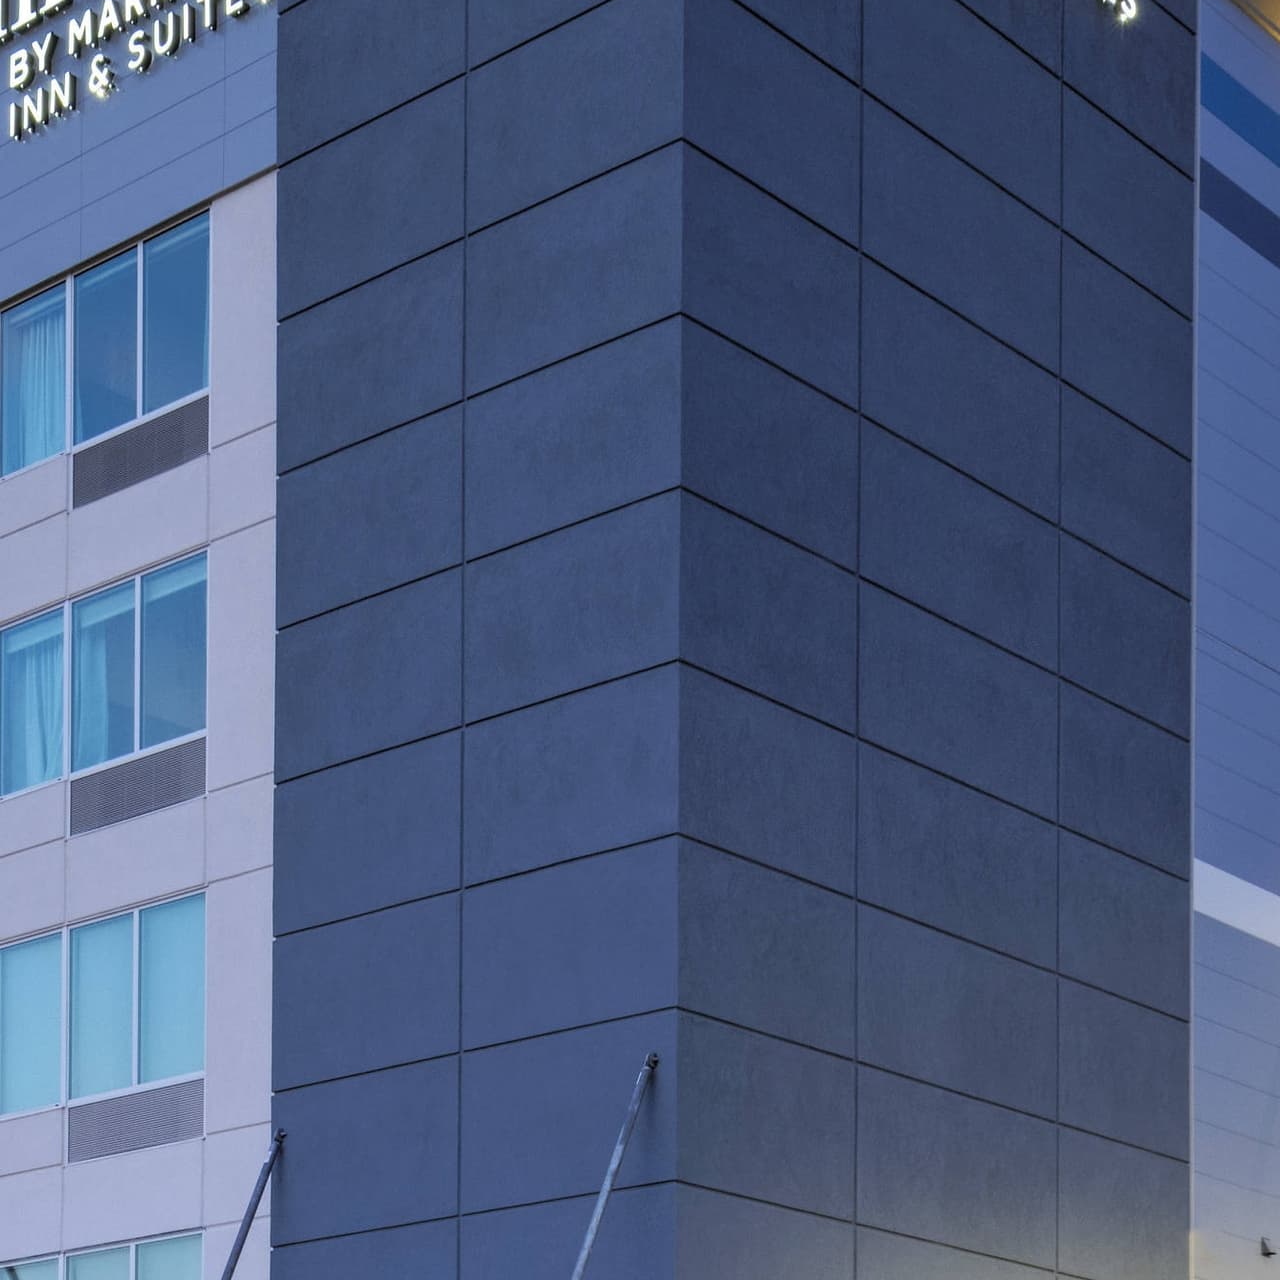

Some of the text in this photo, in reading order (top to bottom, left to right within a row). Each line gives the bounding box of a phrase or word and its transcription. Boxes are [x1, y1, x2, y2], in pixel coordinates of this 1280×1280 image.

[9, 32, 56, 89] BY
[9, 71, 75, 140] INN
[89, 54, 113, 98] &
